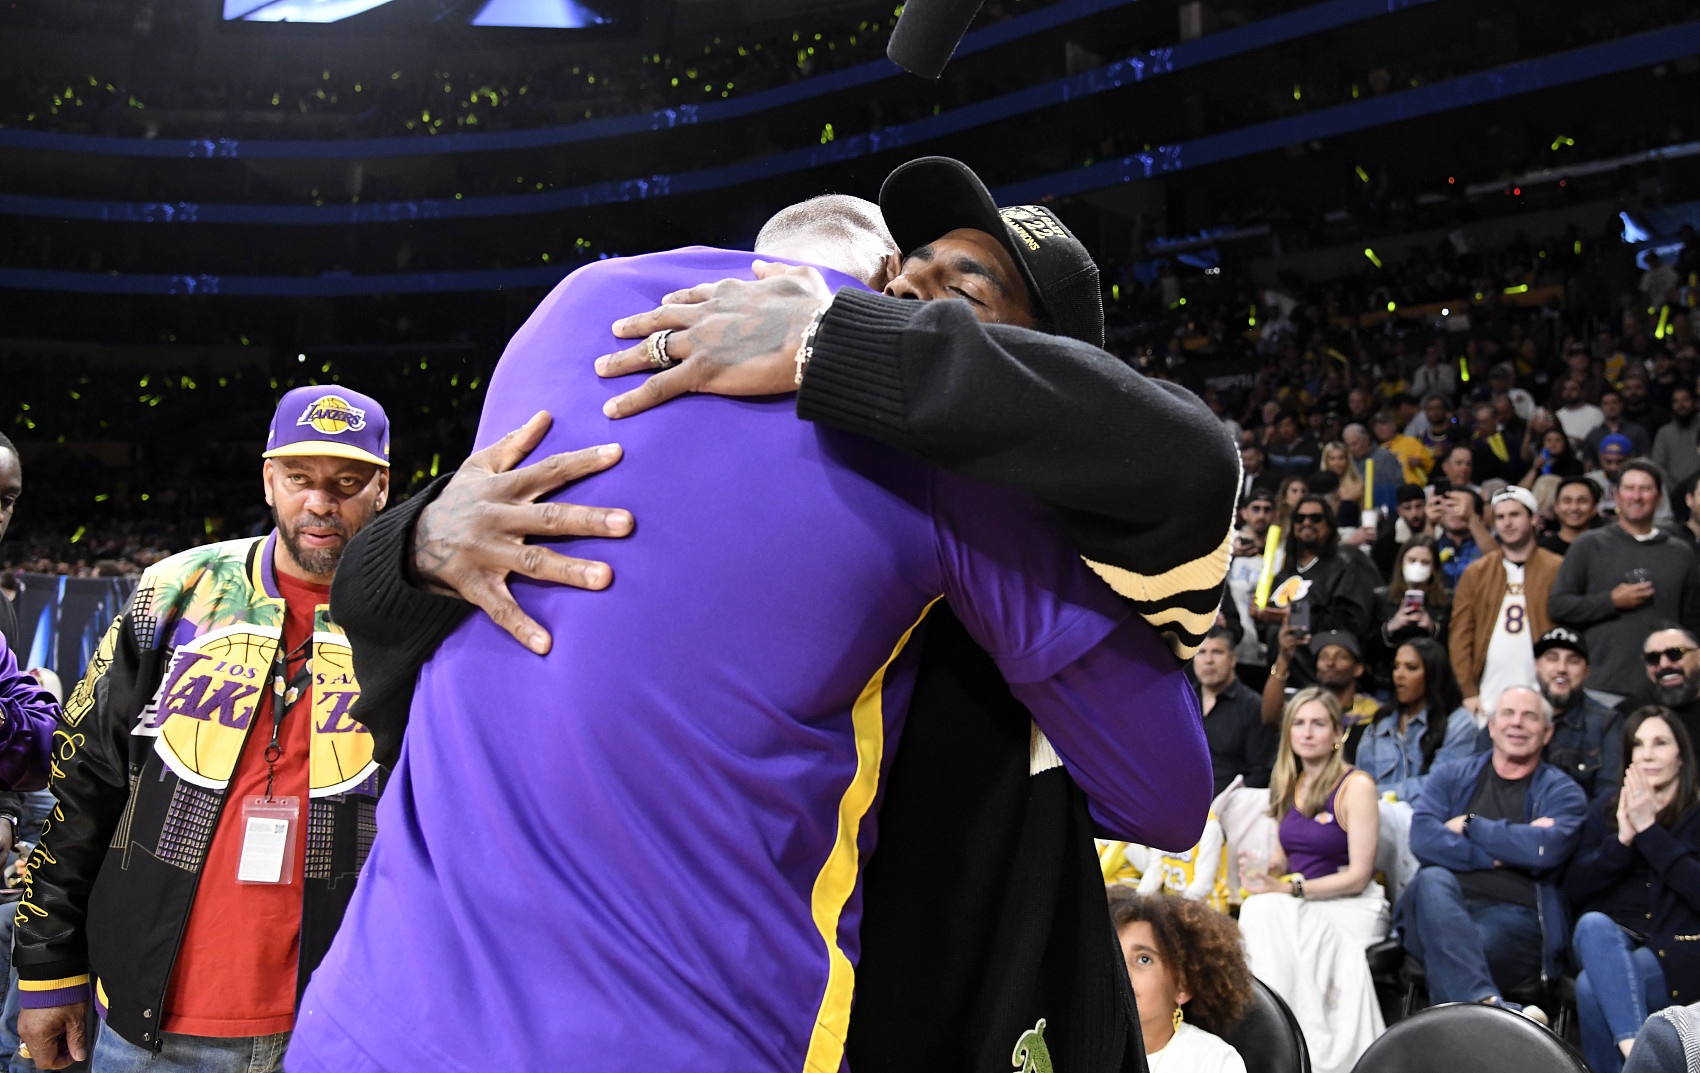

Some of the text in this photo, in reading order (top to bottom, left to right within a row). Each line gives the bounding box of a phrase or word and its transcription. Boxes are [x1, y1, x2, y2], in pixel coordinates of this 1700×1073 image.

[297, 404, 366, 430] LAKERS
[1505, 605, 1524, 634] 8
[213, 661, 258, 679] LOS
[1163, 863, 1187, 892] 23
